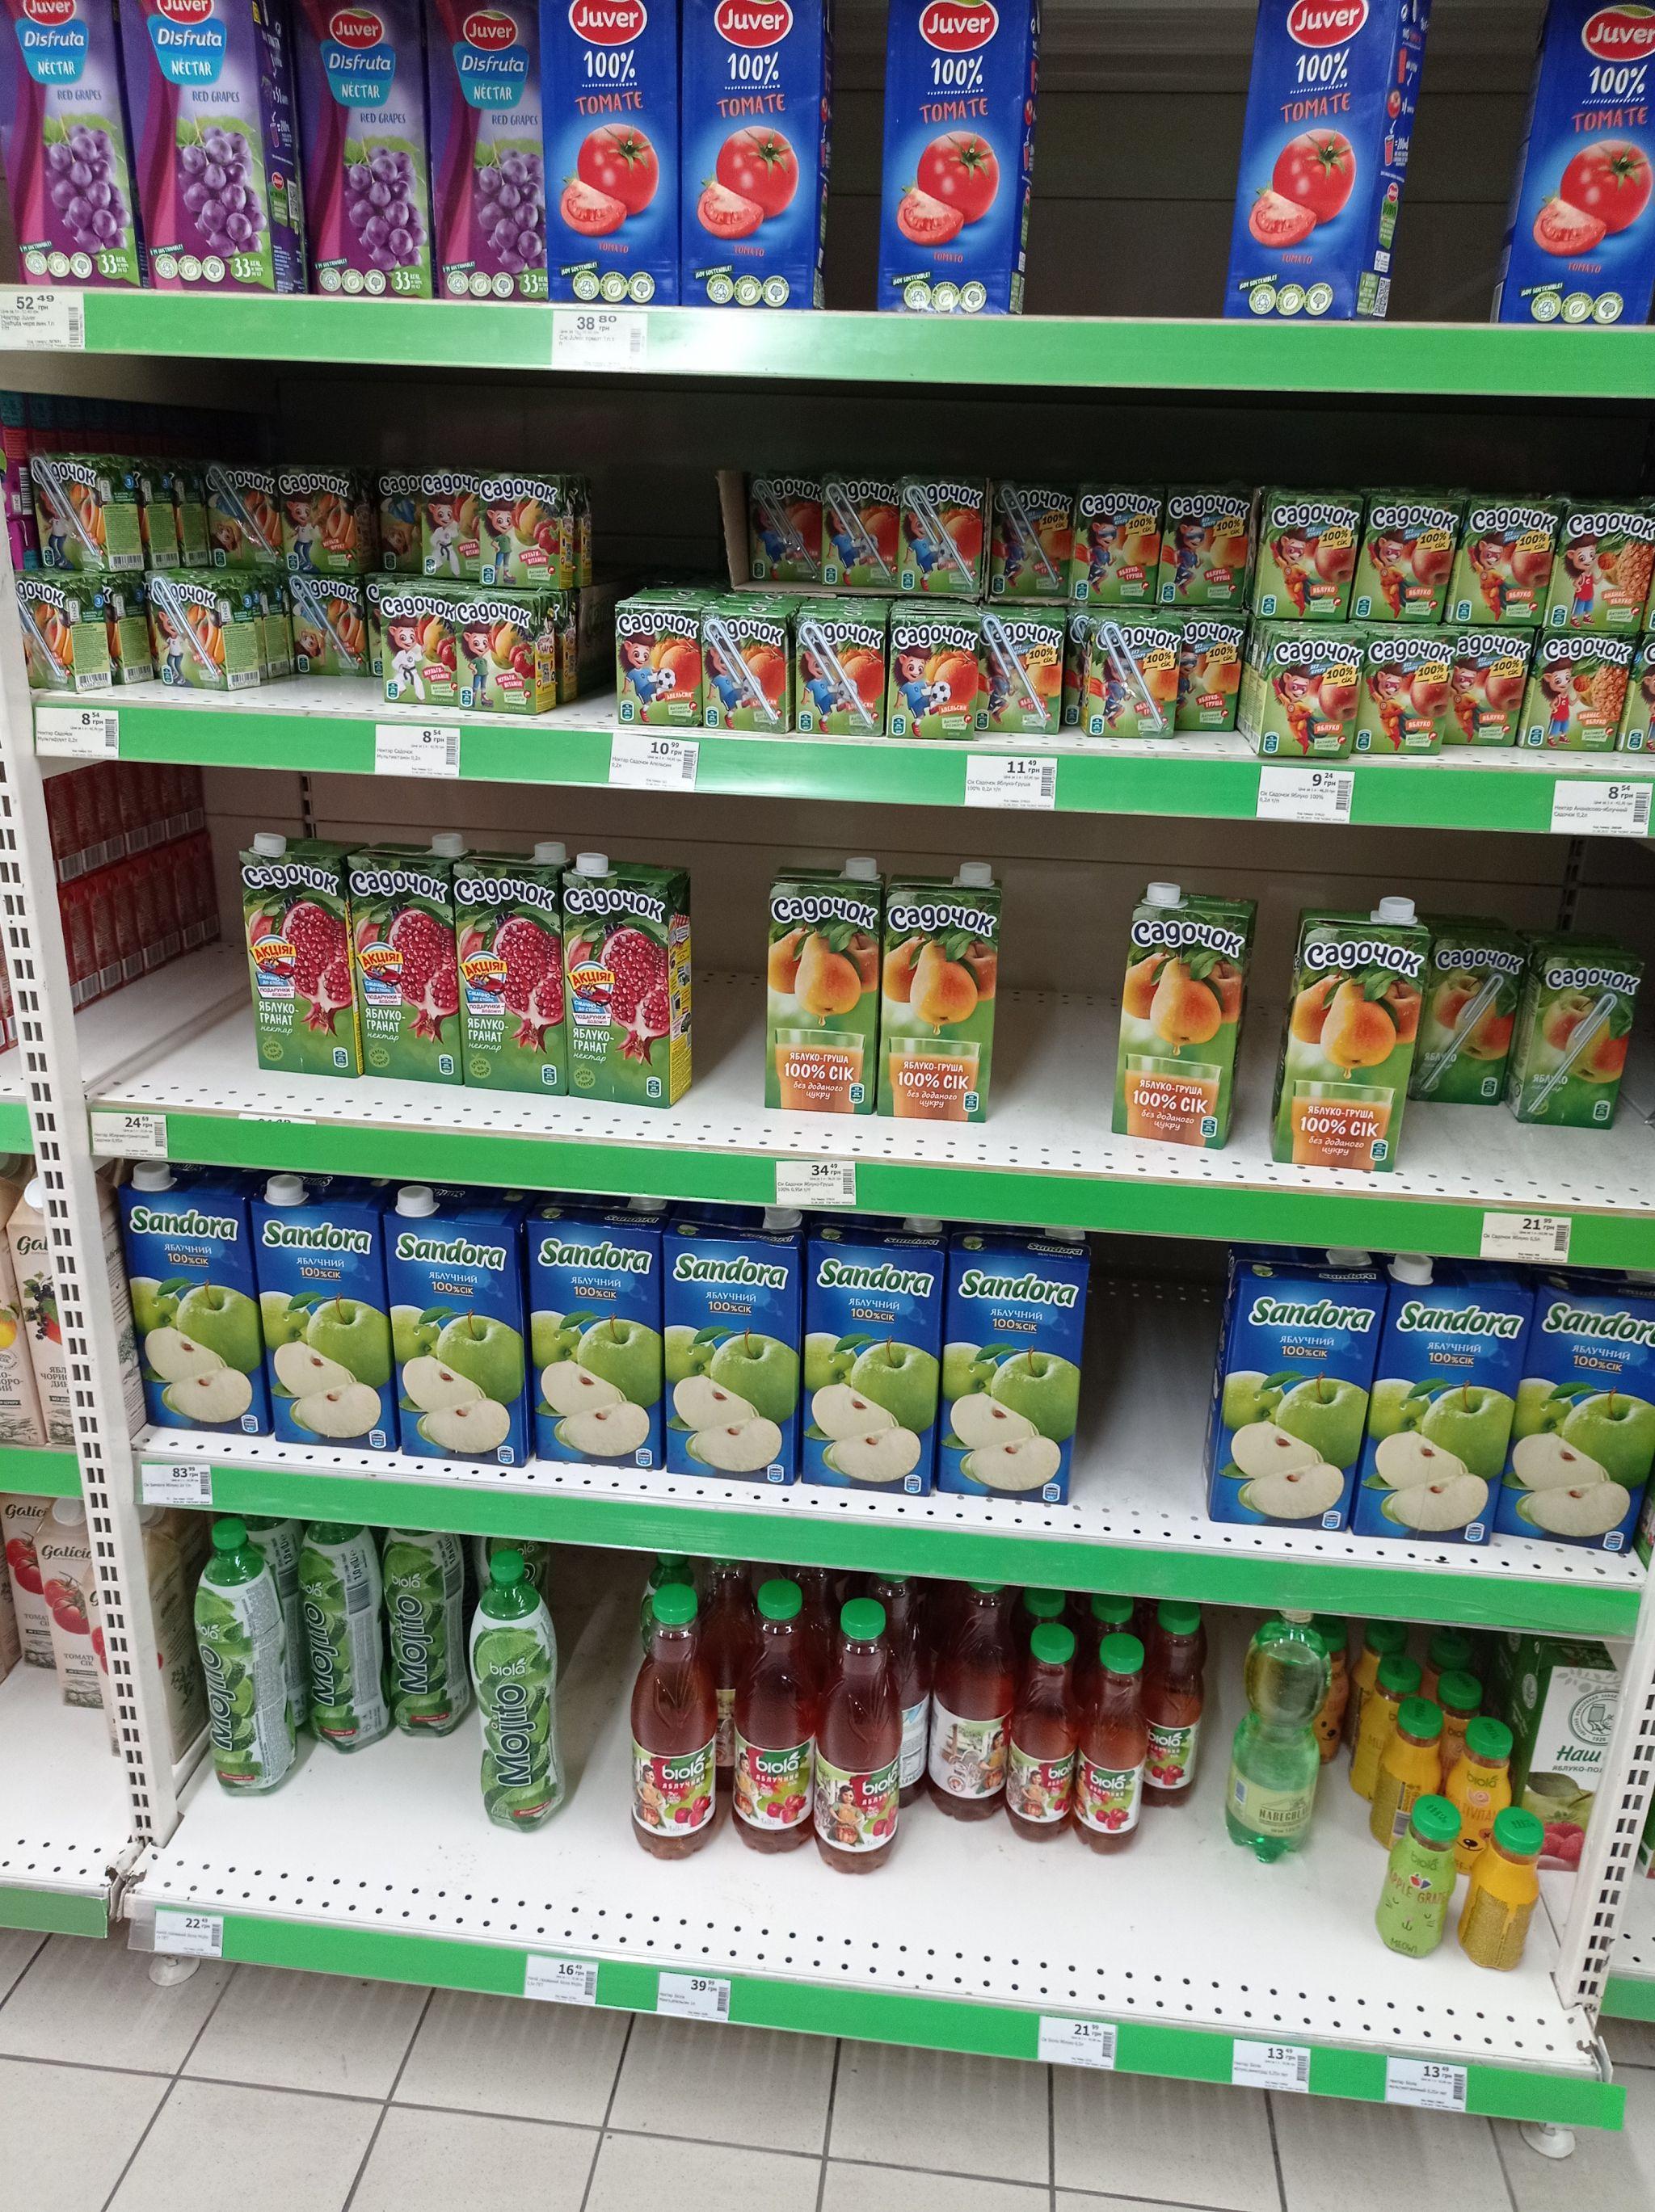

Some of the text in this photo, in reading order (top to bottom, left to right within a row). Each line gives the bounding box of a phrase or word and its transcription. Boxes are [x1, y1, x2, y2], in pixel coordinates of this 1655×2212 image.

[577, 6, 639, 27] Juver
[722, 9, 785, 30] Juver
[927, 13, 991, 34] Juver
[1295, 7, 1360, 31] Juver
[158, 28, 222, 48] Disfruta
[336, 21, 379, 37] Juver
[470, 23, 512, 39] Juver
[1590, 23, 1655, 44] Juver
[24, 31, 85, 48] Disfruta
[38, 60, 76, 76] NÉCTAR
[171, 60, 213, 76] NÉCTAR
[329, 53, 391, 71] Disfruta
[461, 55, 524, 73] Disfruta
[583, 49, 636, 83] 100%
[727, 52, 780, 86] 100%
[1296, 48, 1350, 85] 100%
[931, 56, 983, 90] 100%
[1590, 65, 1648, 99] 100%
[57, 90, 102, 100] RED GRAPES
[342, 82, 381, 99] NÉCTAR
[474, 83, 512, 100] NÉCTAR
[575, 91, 644, 116] TOMATE
[717, 94, 786, 118] TOMATE
[919, 98, 988, 124] TOMATE
[1280, 92, 1351, 124] TOMATE
[360, 113, 406, 124] RED GRAPES
[1572, 106, 1649, 133] TOMATE
[100, 254, 117, 274] 33
[234, 258, 250, 278] 33
[16, 296, 34, 310] 52
[577, 317, 595, 330] 38
[480, 478, 558, 504] Садочок
[1080, 493, 1162, 517] Садочок
[1169, 494, 1250, 519] Садочок
[1272, 504, 1359, 528] Садочок
[1371, 505, 1456, 532] Садочок
[1471, 507, 1558, 533] Садочок
[1322, 529, 1349, 542] 100%
[1567, 513, 1655, 540] Садочок
[1420, 533, 1447, 545] 100%
[1519, 534, 1547, 546] 100%
[382, 596, 455, 621] Садочок
[457, 603, 531, 628] Садочок
[617, 613, 699, 638] Садочок
[893, 625, 978, 650] Садочок
[1275, 641, 1363, 666] Садочок
[1371, 639, 1454, 664] Садочок
[1543, 637, 1632, 663] Садочок
[1327, 667, 1354, 679] 100%
[1418, 666, 1444, 678] 100%
[82, 713, 91, 725] 8
[1316, 723, 1340, 732] ЯБЛУКО
[1408, 720, 1431, 728] ЯБЛУКО
[423, 731, 432, 742] 8
[651, 742, 669, 755] 10
[1007, 761, 1025, 773] 11
[1312, 774, 1322, 786] 9
[1609, 787, 1619, 799] 8
[243, 864, 339, 895] Садочок
[350, 870, 448, 902] Садочок
[456, 878, 556, 910] Садочок
[564, 888, 666, 923] Садочок
[771, 896, 878, 929] Садочок
[889, 904, 997, 937] Садочок
[1131, 919, 1247, 959] Садочок
[255, 946, 294, 960] АКЦІЯ!
[363, 953, 401, 967] АКЦІЯ!
[1303, 940, 1425, 978] Садочок
[1436, 948, 1525, 975] Садочок
[465, 963, 504, 977] АКЦІЯ!
[571, 973, 612, 985] АКЦІЯ!
[1545, 968, 1641, 996] Садочок
[259, 1001, 299, 1014] ЯБЛУКО-
[259, 1014, 293, 1026] ГРАНАТ
[260, 1025, 293, 1035] нектар
[573, 1027, 615, 1041] ЯБЛУКО-
[573, 1040, 608, 1053] ГРАНАТ
[573, 1051, 607, 1062] нектар
[789, 1052, 849, 1064] ЯБЛУКО-ГРУША
[784, 1063, 854, 1082] 100% СІК
[903, 1060, 964, 1073] ЯБЛУКО-ГРУША
[794, 1081, 843, 1092] без доданого
[897, 1071, 970, 1091] 100% СІК
[1139, 1079, 1203, 1096] ЯБЛУКО-ГРУША
[806, 1091, 830, 1100] цукру
[1133, 1089, 1209, 1115] 100% СІК
[1307, 1104, 1375, 1120] ЯБЛУКО-ГРУША
[124, 1117, 141, 1128] 24
[1299, 1116, 1380, 1138] 100% СІК
[1308, 1136, 1365, 1149] без доданого
[1321, 1146, 1350, 1156] цукру
[811, 1165, 829, 1175] 34
[128, 1206, 240, 1242] Sandora
[1522, 1218, 1540, 1230] 21
[263, 1219, 372, 1254] Sandora
[395, 1233, 507, 1271] Sandora
[538, 1237, 653, 1274] Sandora
[673, 1253, 790, 1290] Sandora
[817, 1257, 935, 1298] Sandora
[571, 1276, 621, 1288] ЯБЛУЧНИЙ
[958, 1269, 1080, 1308] Sandora
[705, 1290, 756, 1302] ЯБЛУЧНИЙ
[849, 1297, 900, 1310] ЯБЛУЧНИЙ
[1249, 1296, 1375, 1332] Sandora
[1396, 1300, 1524, 1339] Sandora
[1280, 1335, 1335, 1347] ЯБЛУЧНИЙ
[173, 1468, 187, 1478] 83
[310, 1600, 335, 1707] Mojito
[398, 1594, 427, 1695] Mojito
[199, 1642, 235, 1752] Mojito
[497, 1683, 533, 1787] Mojito
[1556, 1745, 1602, 1763] Наш
[186, 1917, 200, 1928] 22
[558, 1964, 574, 1975] 16
[691, 1979, 707, 1991] 39
[1074, 2024, 1089, 2036] 21
[1267, 2048, 1284, 2059] 13
[1424, 2066, 1441, 2077] 13
